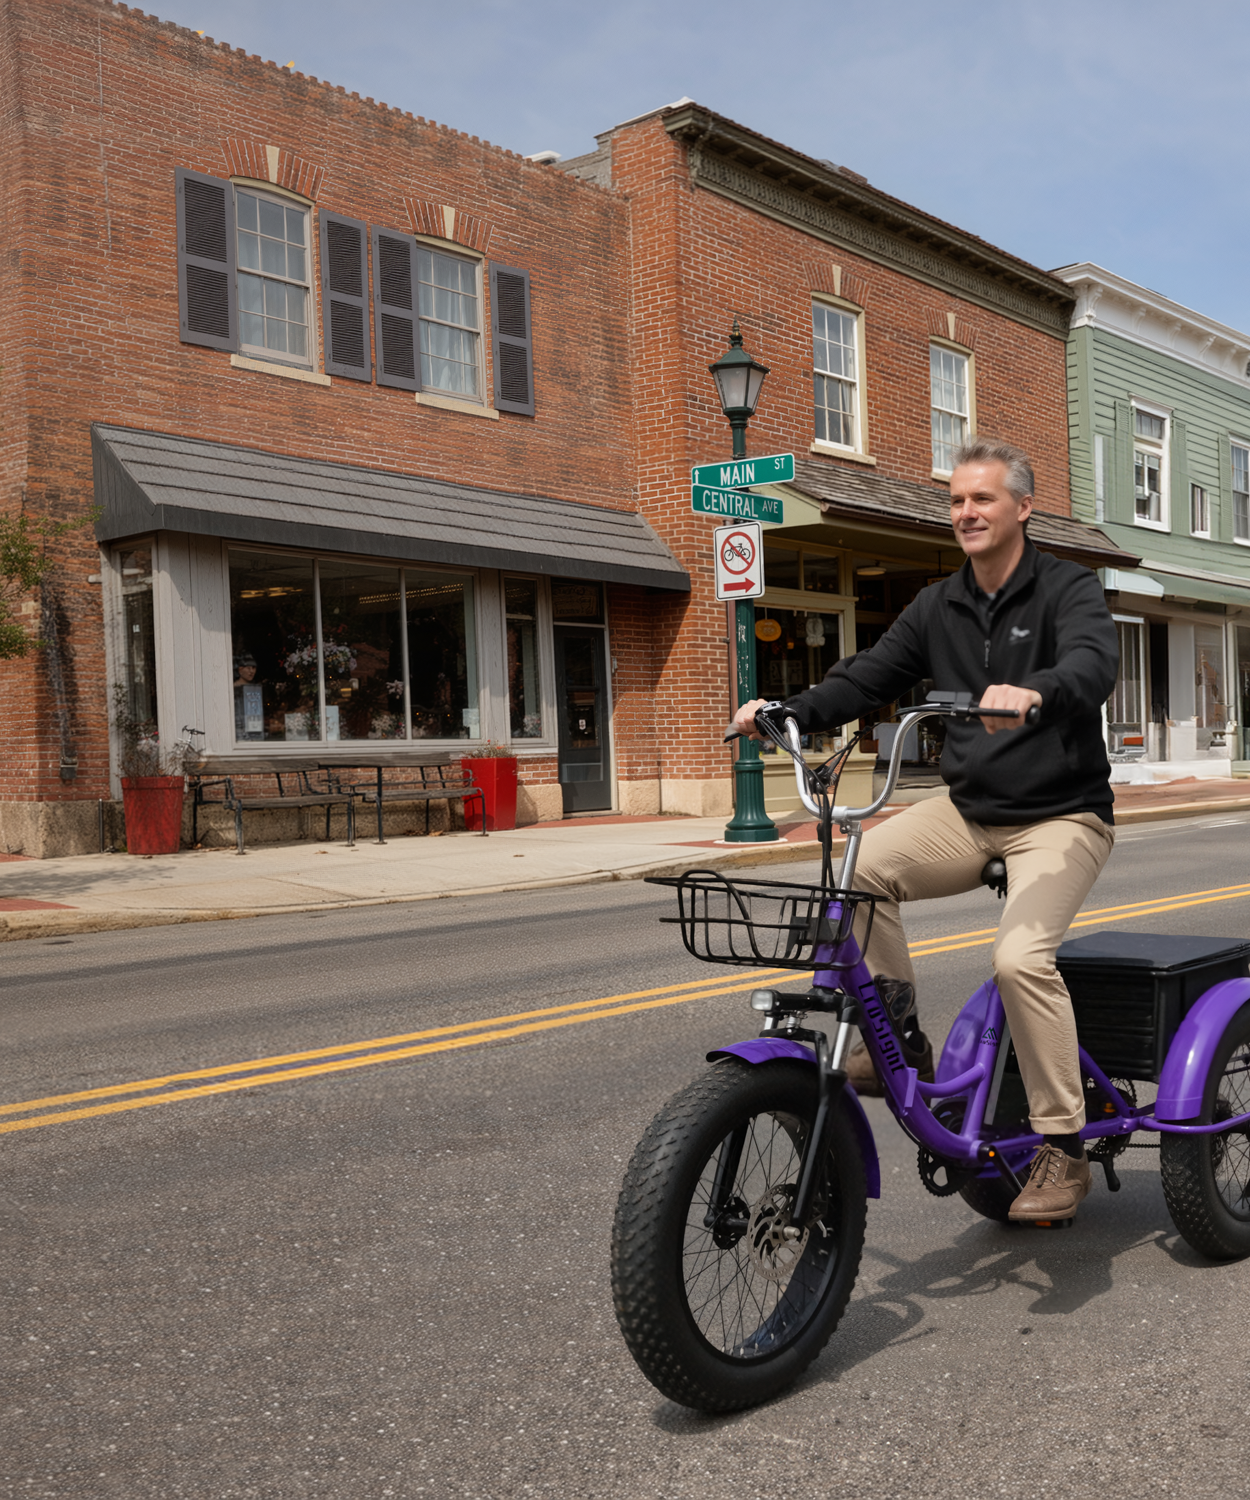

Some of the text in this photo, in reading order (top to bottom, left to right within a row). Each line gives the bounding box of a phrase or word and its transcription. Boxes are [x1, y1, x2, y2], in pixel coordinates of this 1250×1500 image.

[720, 457, 785, 486] MAIN ST
[702, 490, 779, 518] CENTRAL AVE
